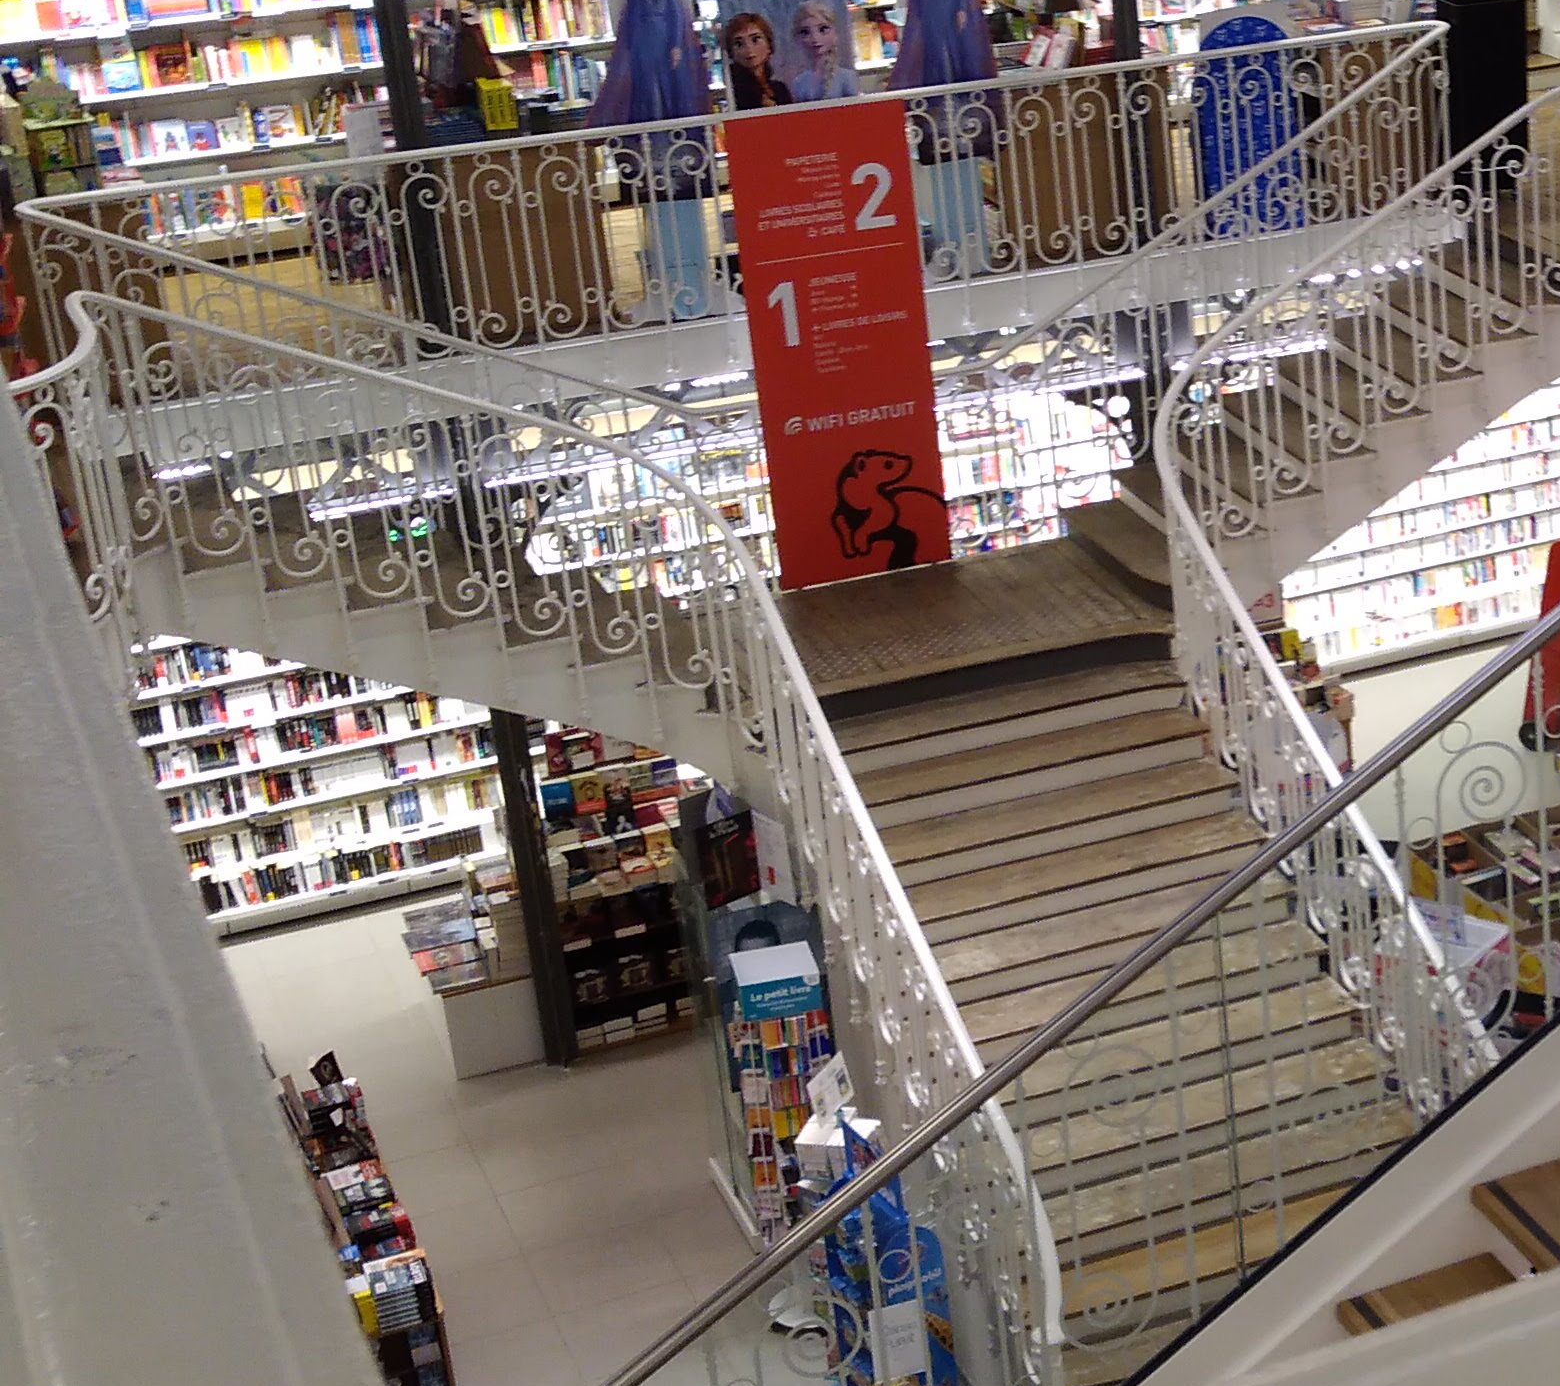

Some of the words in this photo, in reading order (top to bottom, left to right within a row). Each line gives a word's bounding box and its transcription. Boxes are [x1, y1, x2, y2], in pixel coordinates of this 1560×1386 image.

[851, 162, 898, 232] 2
[766, 281, 801, 347] 1
[806, 414, 844, 434] WIFI
[846, 400, 916, 428] GRATUIT
[750, 993, 763, 1003] Le
